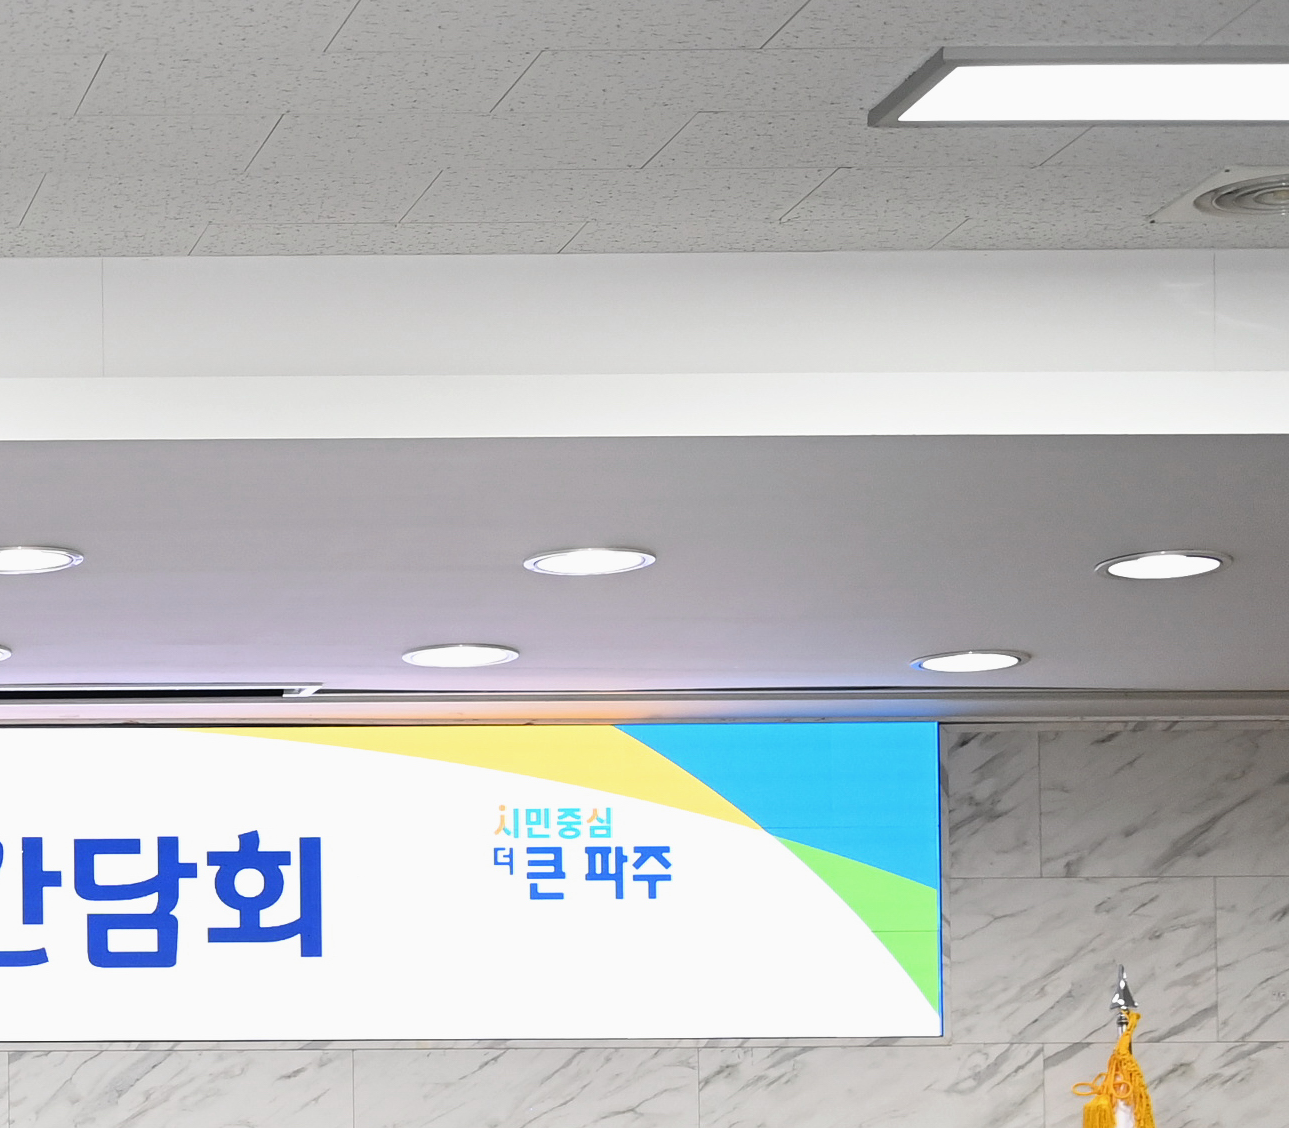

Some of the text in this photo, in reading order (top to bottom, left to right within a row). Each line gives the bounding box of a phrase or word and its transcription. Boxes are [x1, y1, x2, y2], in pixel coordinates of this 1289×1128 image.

[493, 804, 613, 840] 시민중심
[493, 846, 673, 900] 더 큰 파주
